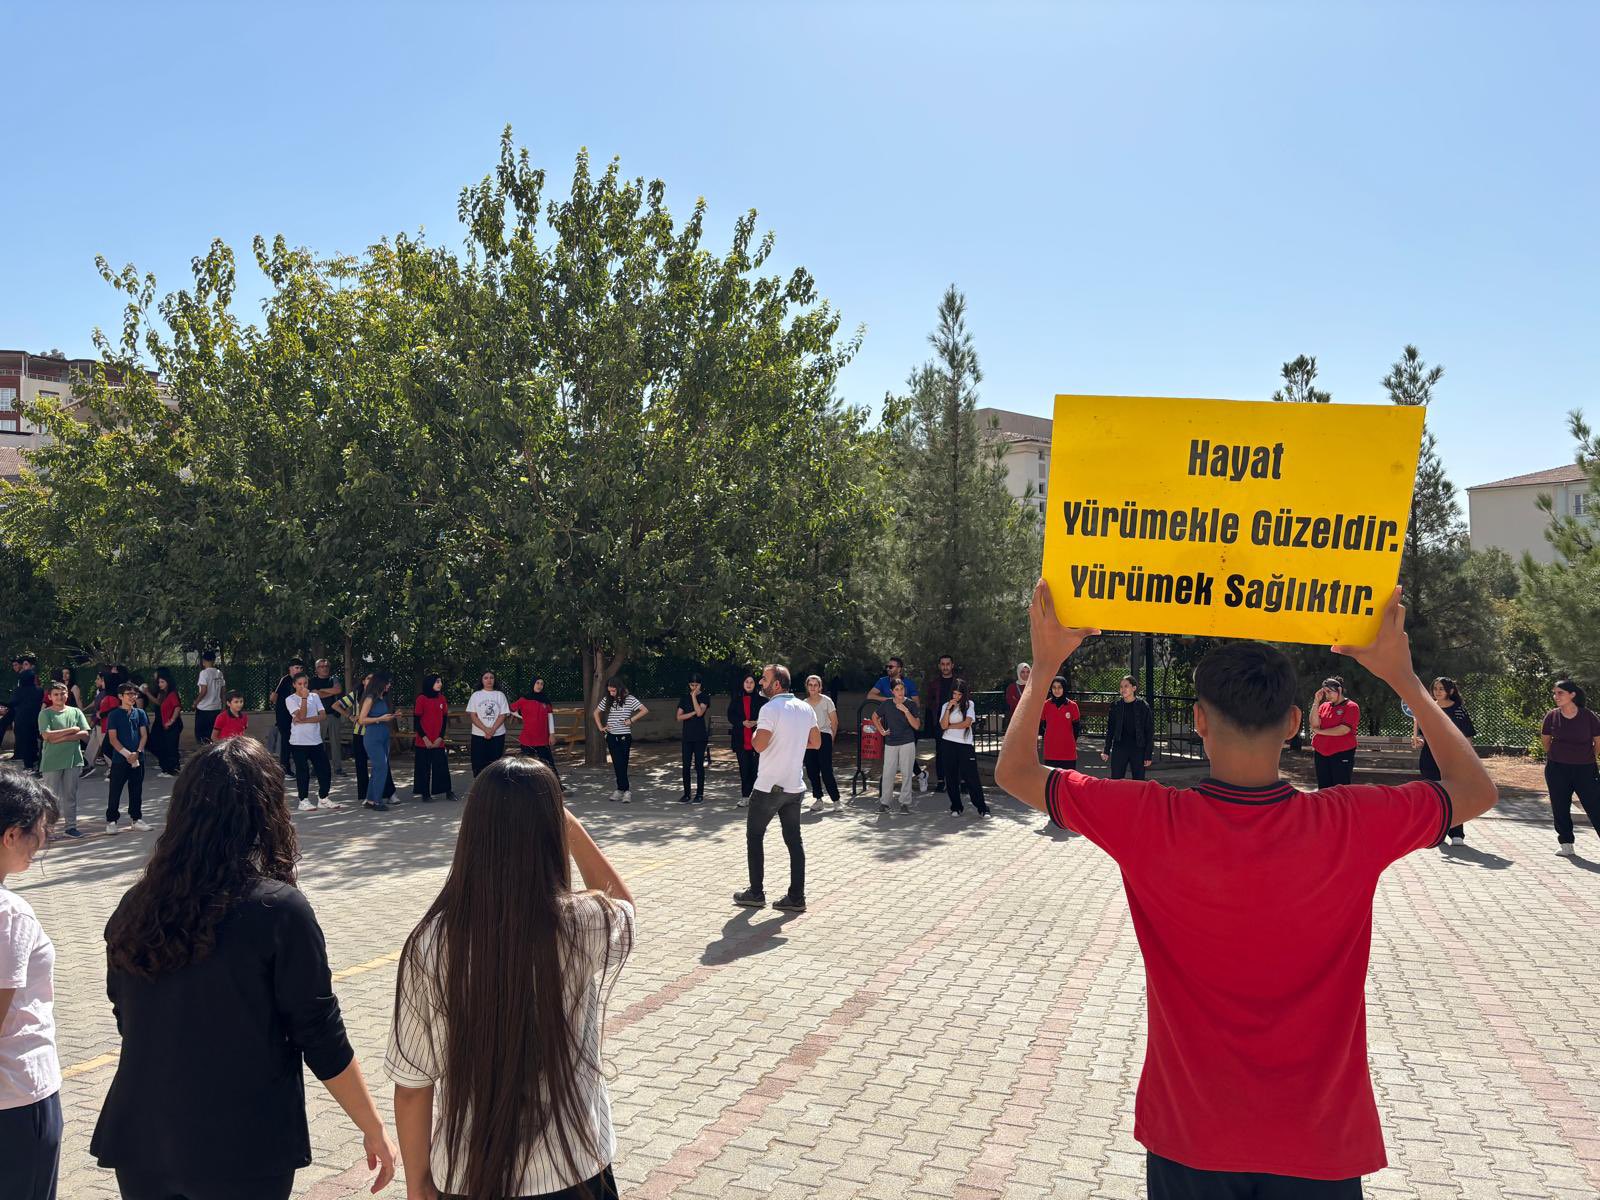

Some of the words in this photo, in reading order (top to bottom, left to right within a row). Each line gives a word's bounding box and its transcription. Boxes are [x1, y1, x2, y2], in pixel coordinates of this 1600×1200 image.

[1188, 440, 1285, 482] Hayat
[1063, 500, 1240, 543] Yürümekle
[1251, 508, 1399, 552] Güzeldir.
[1071, 564, 1214, 606] Yürümek
[1224, 573, 1374, 617] Sağlıktır.
